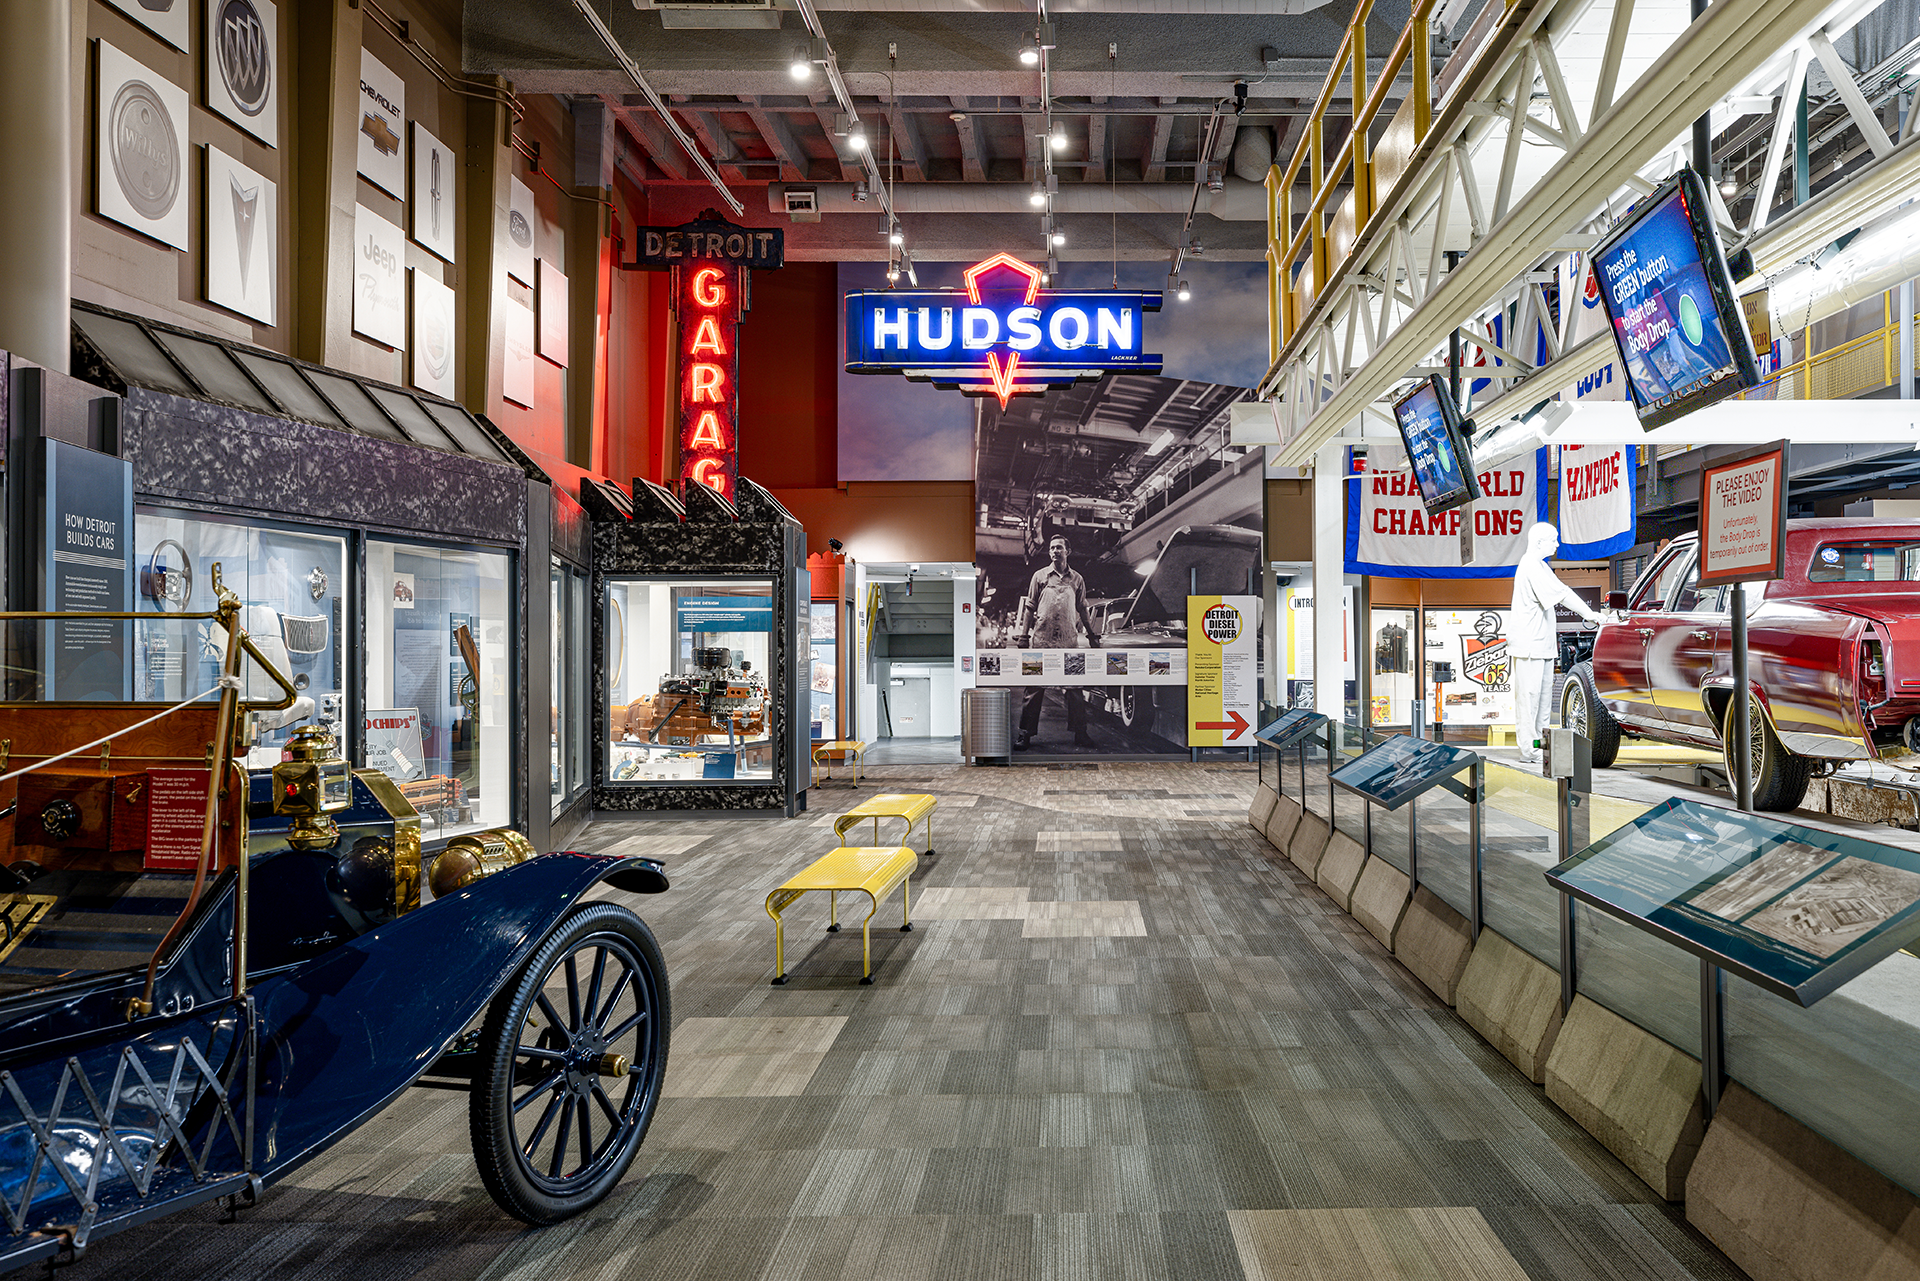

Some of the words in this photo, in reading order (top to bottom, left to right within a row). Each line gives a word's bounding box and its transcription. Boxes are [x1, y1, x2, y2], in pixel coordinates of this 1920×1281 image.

[360, 80, 400, 118] CHEVROLET
[125, 126, 167, 170] Willys
[511, 215, 526, 239] Ford
[364, 234, 396, 278] Jeep
[645, 231, 774, 259] DETROIT
[1605, 258, 1624, 282] Press
[1622, 249, 1638, 268] the
[1612, 269, 1641, 304] GREEN
[1637, 254, 1669, 286] button
[1621, 316, 1631, 330] to
[1629, 306, 1646, 326] start
[1643, 298, 1658, 316] the
[874, 307, 1132, 350] HUDSON
[1627, 328, 1650, 354] Body
[1647, 318, 1670, 343] Drop
[1400, 413, 1410, 425] Press
[1408, 408, 1416, 420] the
[1406, 420, 1420, 439] GREEN
[1415, 456, 1428, 470] Body
[1424, 452, 1436, 466] Drop
[1372, 469, 1421, 496] NBA
[1477, 470, 1525, 497] RLD
[1716, 474, 1742, 494] PLEASE
[1744, 468, 1770, 488] ENJOY
[1722, 492, 1737, 508] THE
[1738, 486, 1762, 505] VIDEO
[66, 513, 84, 529] HOW
[86, 518, 116, 535] DETROIT
[1372, 508, 1523, 536] CHAMPONS
[66, 530, 94, 548] BUILDS
[96, 536, 114, 550] CARS
[1720, 534, 1728, 544] the
[1729, 532, 1742, 543] Body
[1742, 529, 1755, 541] Drop
[1756, 528, 1760, 538] is
[1710, 546, 1738, 560] temporarily
[1738, 546, 1748, 556] out
[1748, 543, 1754, 554] of
[1754, 542, 1769, 553] order.
[1206, 610, 1239, 620] DETROIT
[1209, 620, 1236, 628] DIESEL
[1208, 630, 1237, 638] POWER
[1465, 647, 1508, 672] Ziebar
[1483, 662, 1508, 685] 65
[1482, 684, 1510, 692] YEARS
